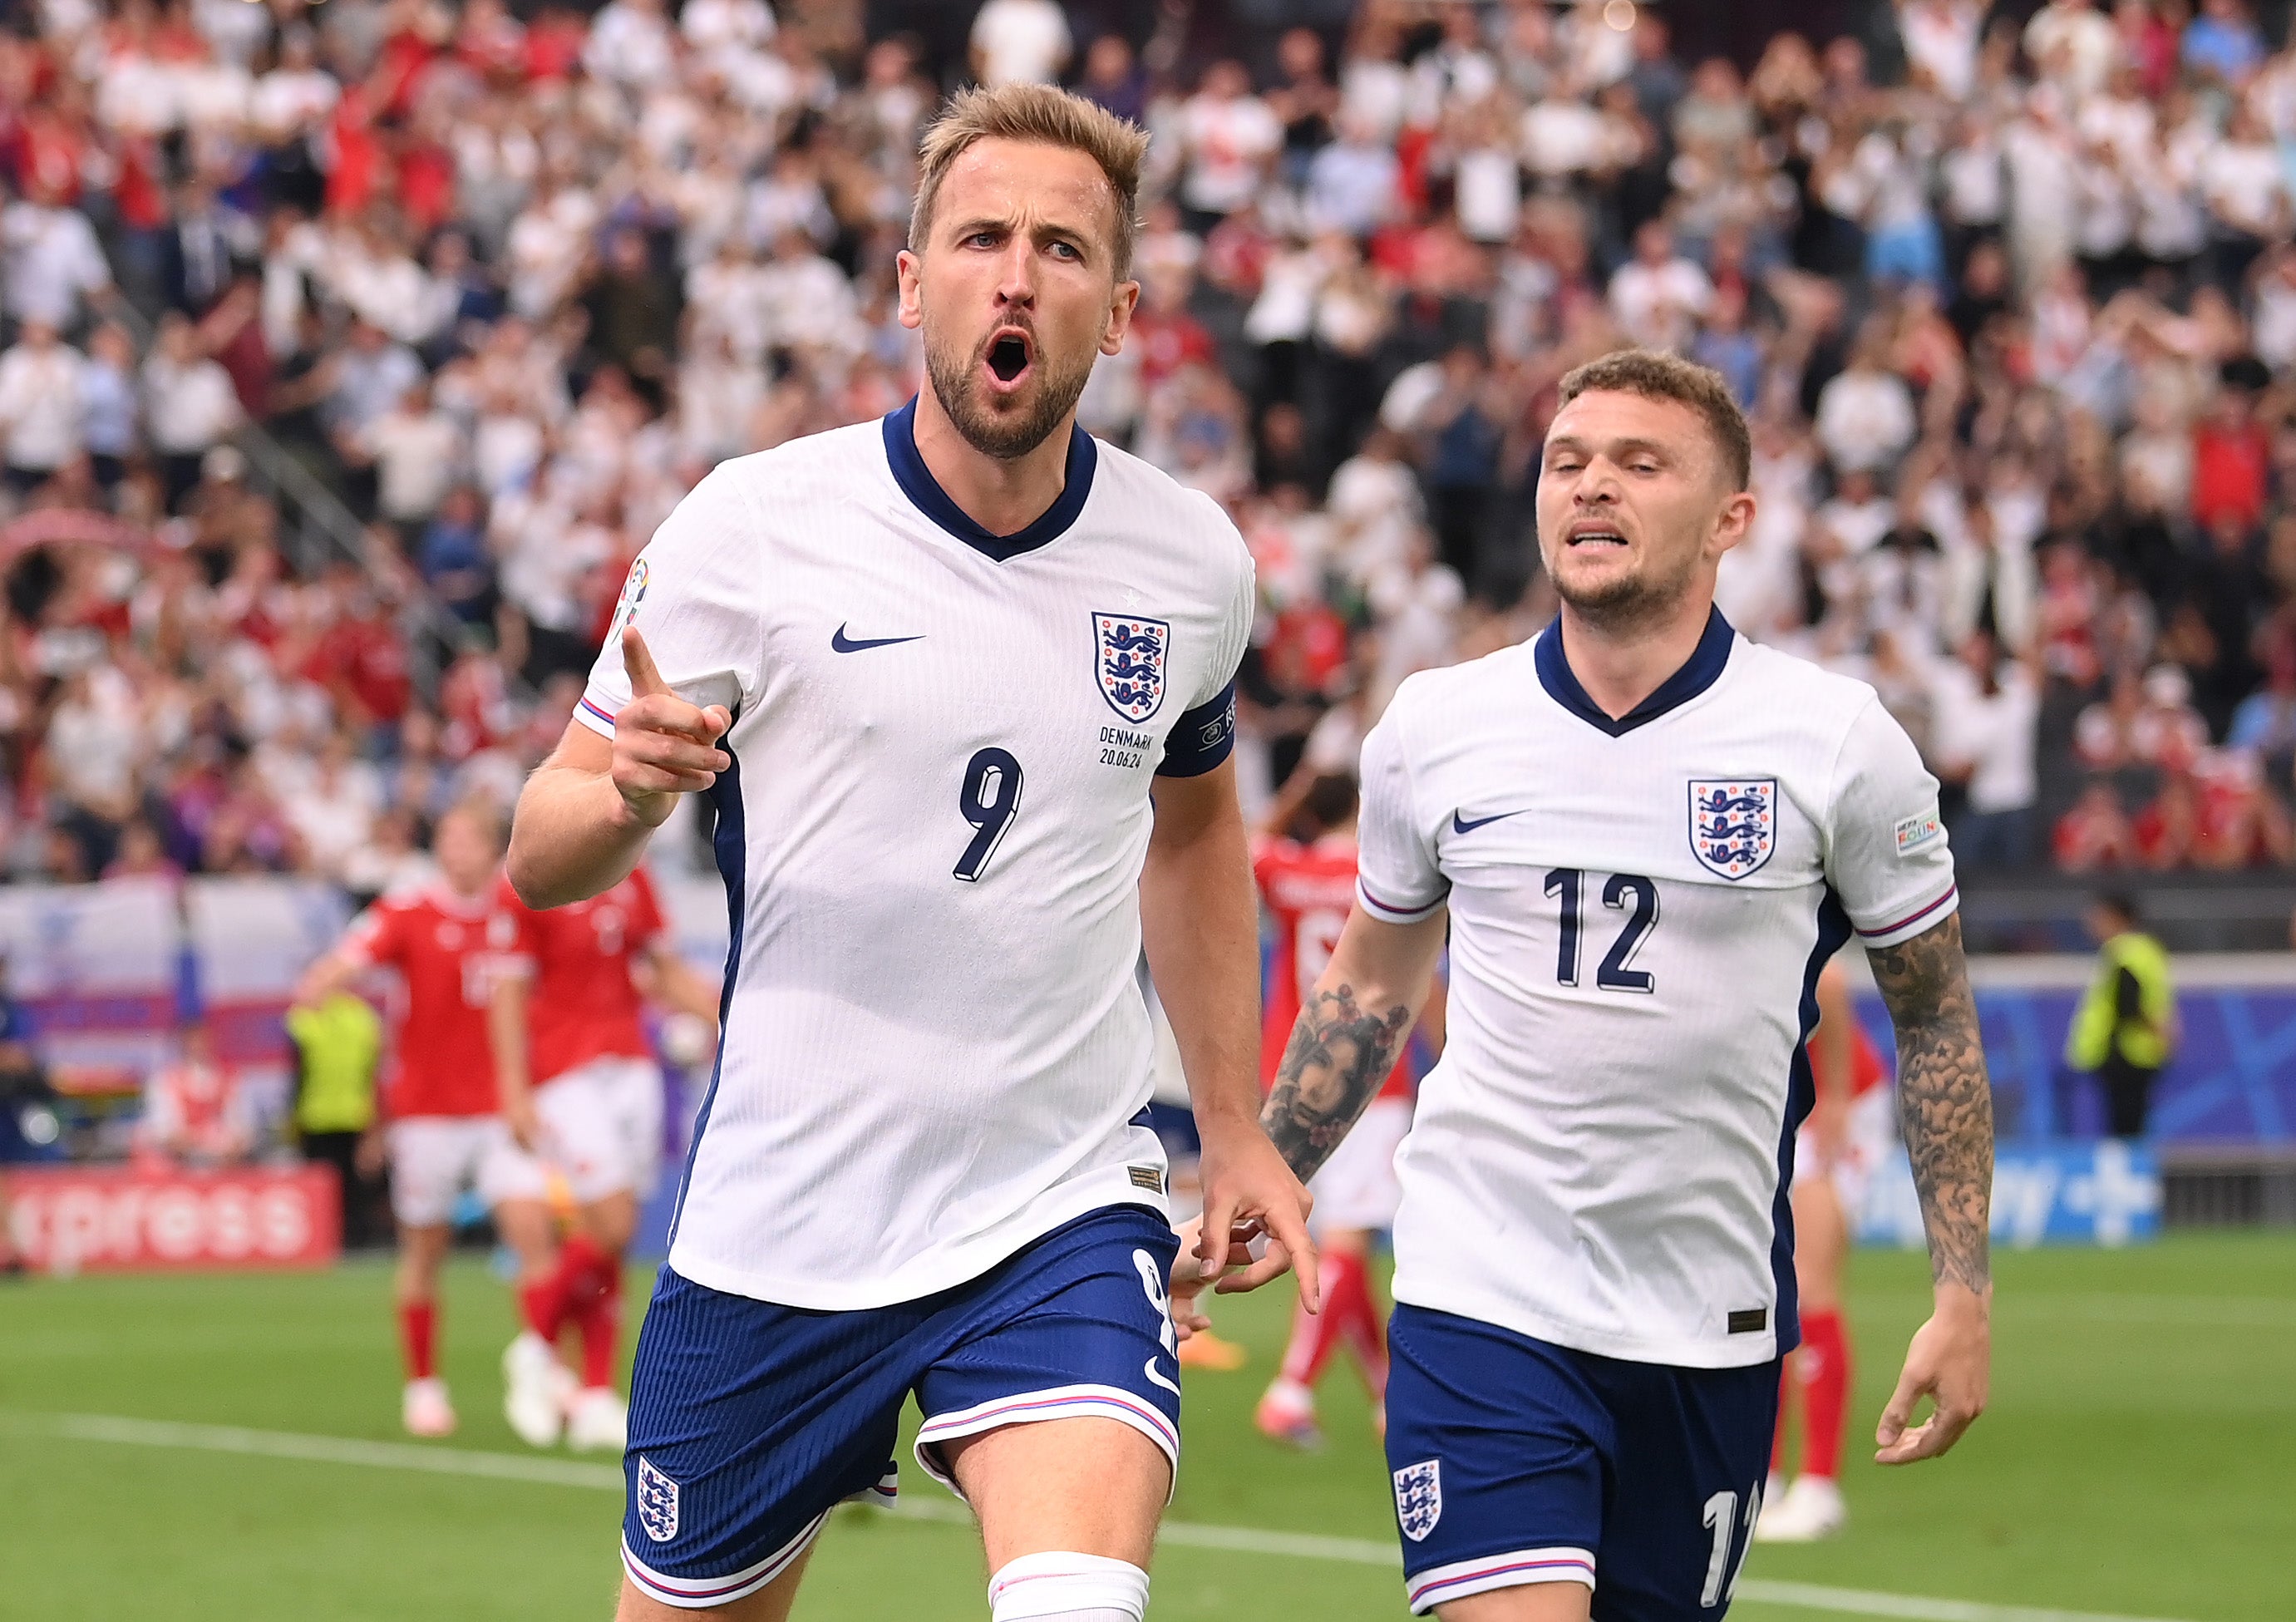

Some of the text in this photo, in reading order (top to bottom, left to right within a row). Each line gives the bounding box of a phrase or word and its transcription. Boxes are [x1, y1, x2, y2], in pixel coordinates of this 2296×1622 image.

[1100, 727, 1153, 750] DENMARK
[1100, 748, 1142, 769] 20.06.24
[953, 747, 1024, 882] 9
[1544, 867, 1660, 993] 12
